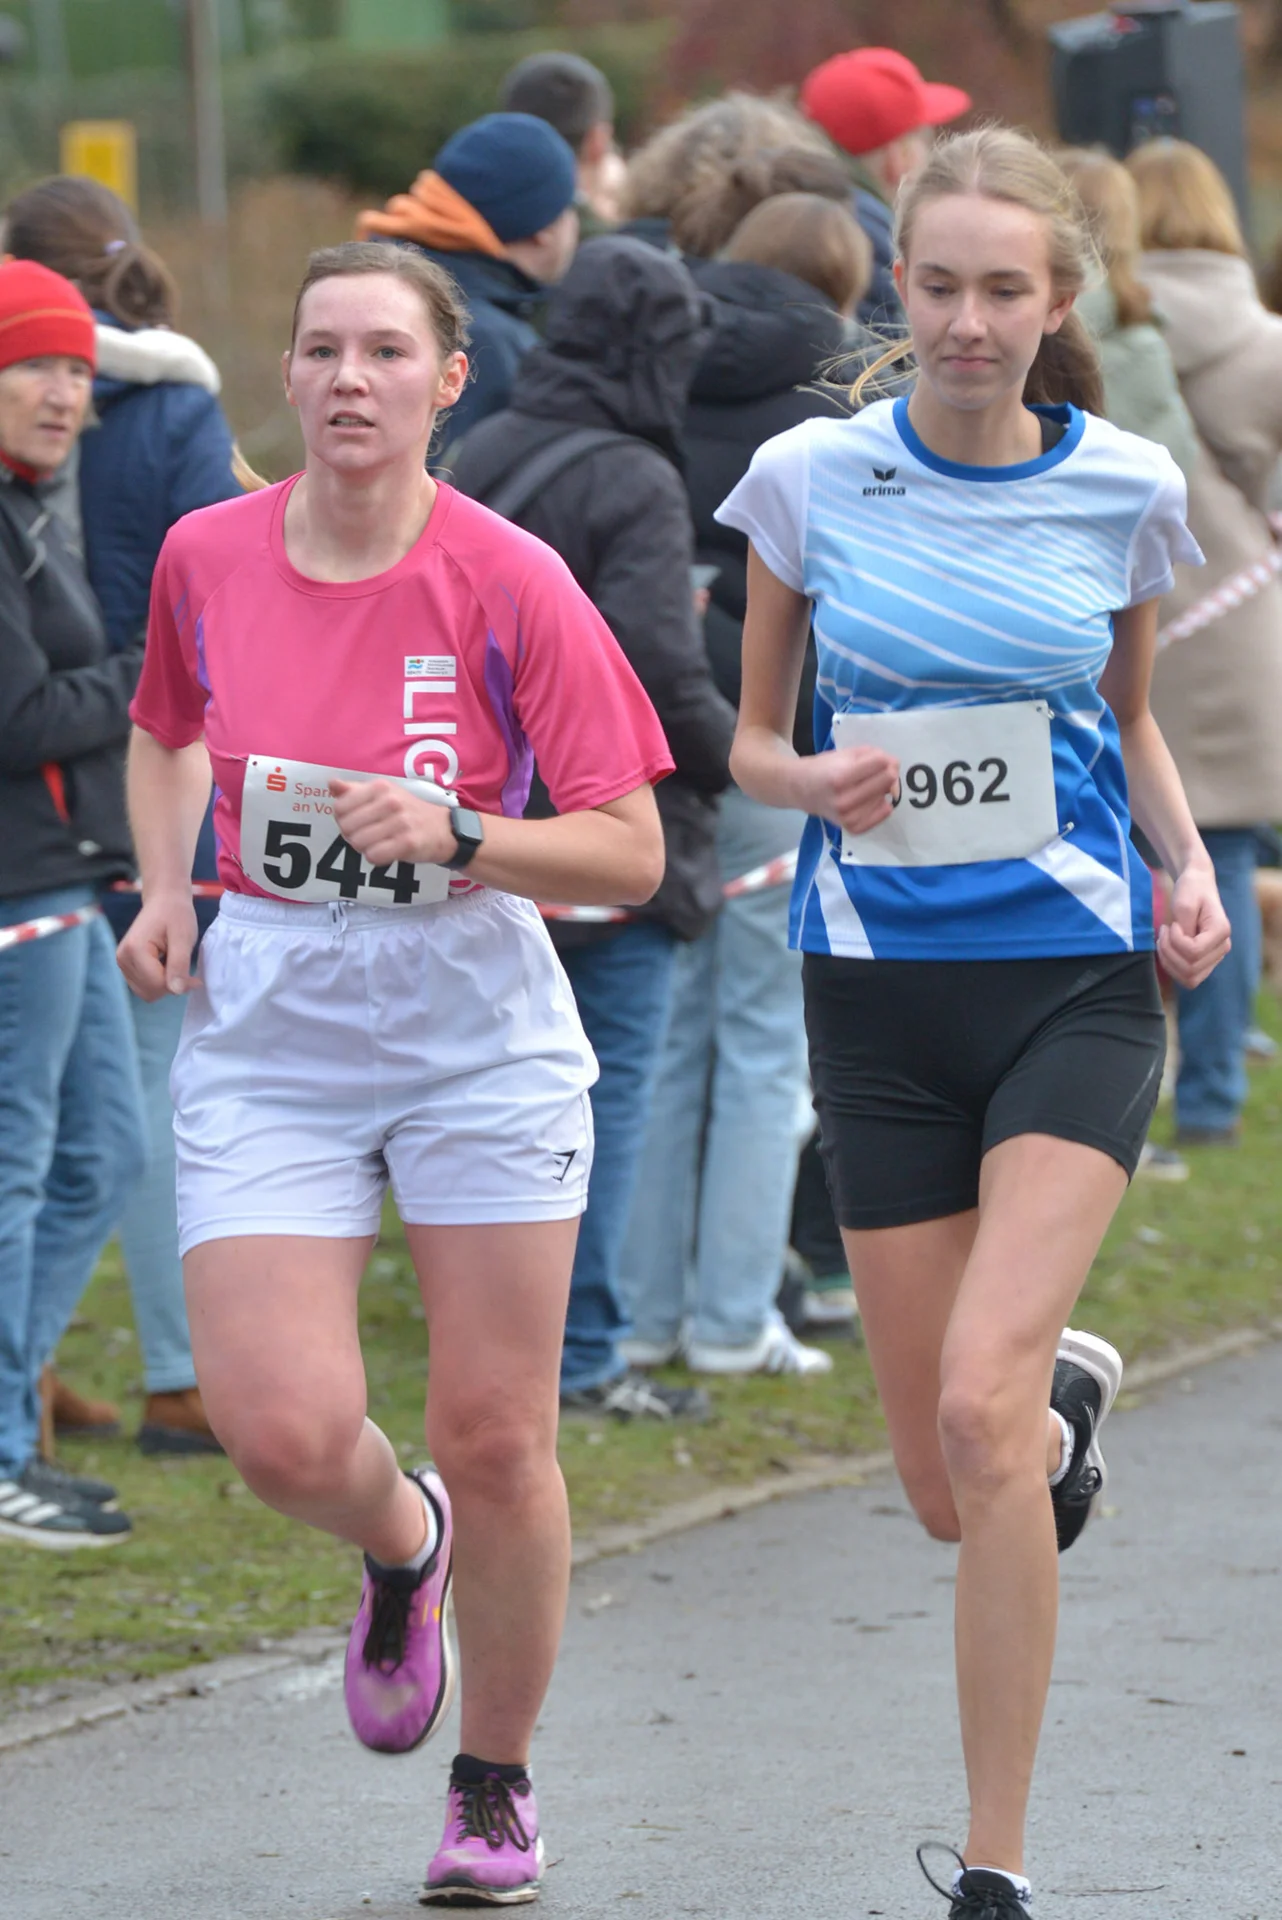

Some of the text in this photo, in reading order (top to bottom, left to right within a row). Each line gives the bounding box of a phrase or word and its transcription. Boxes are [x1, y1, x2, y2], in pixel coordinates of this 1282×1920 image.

[862, 484, 907, 497] erima
[892, 757, 1011, 809] 962
[292, 800, 310, 813] an
[262, 819, 420, 905] 544
